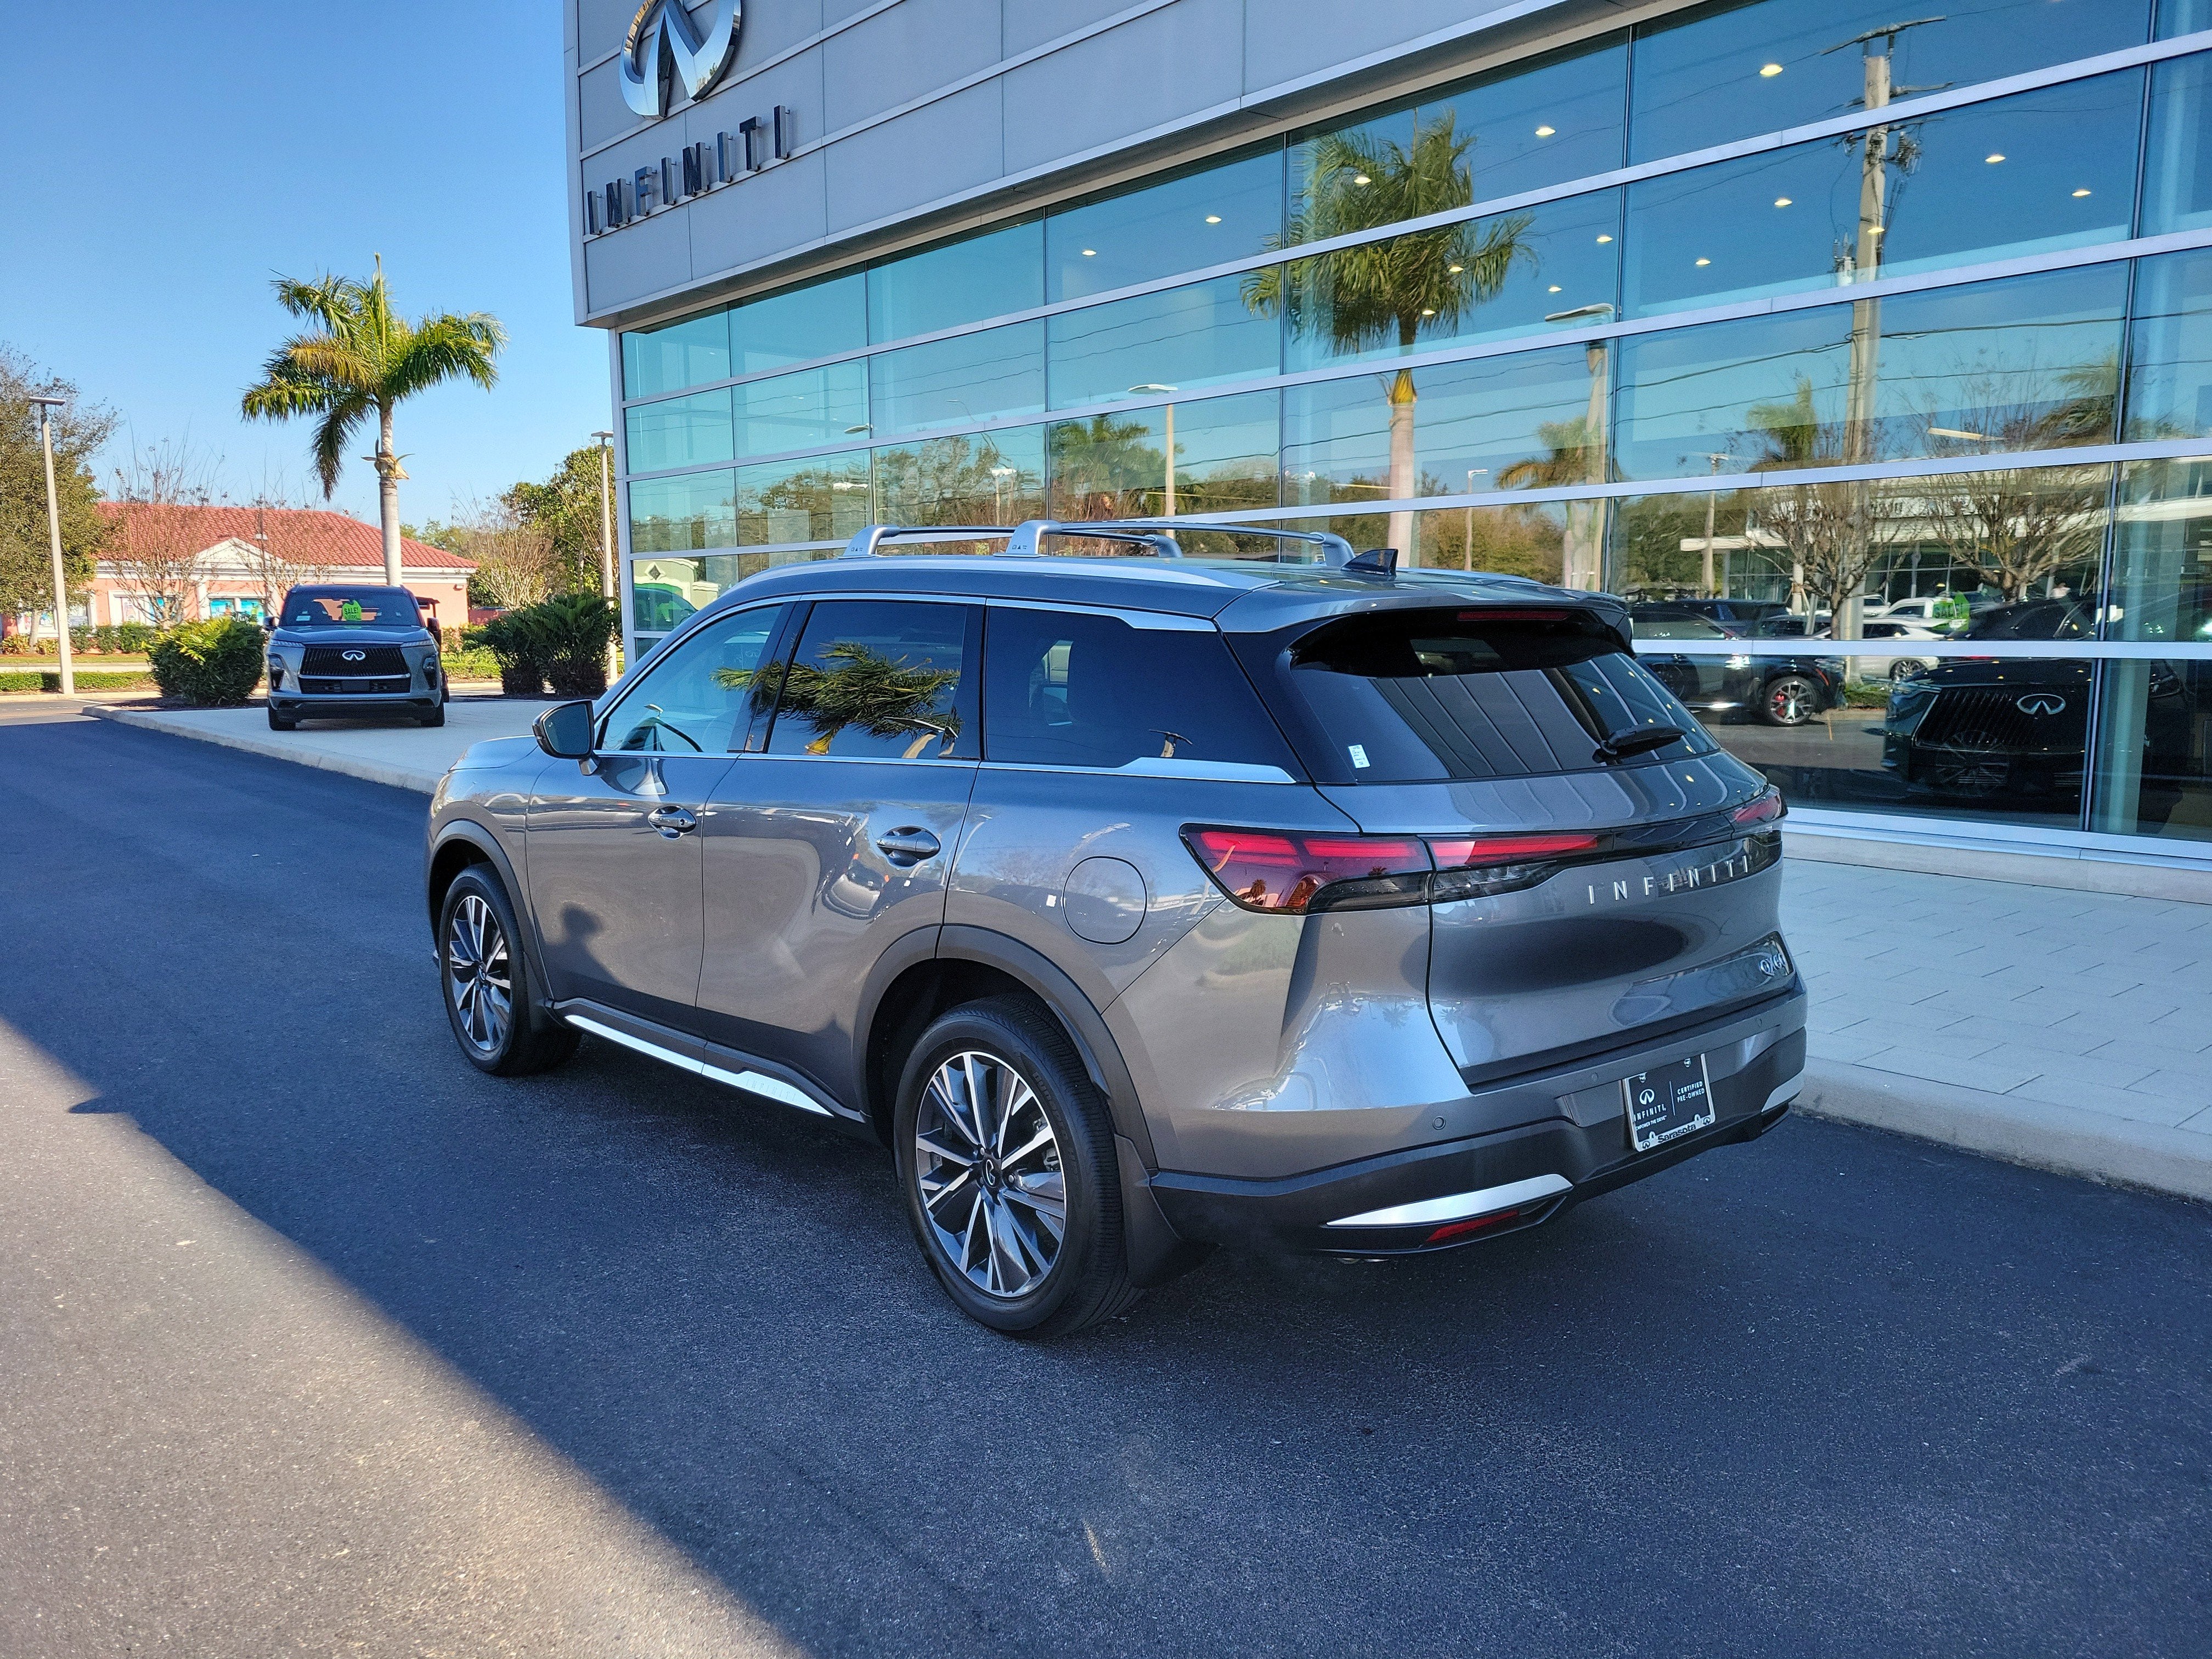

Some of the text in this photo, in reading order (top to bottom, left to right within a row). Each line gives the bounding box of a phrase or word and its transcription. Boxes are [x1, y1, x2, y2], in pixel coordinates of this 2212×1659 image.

[587, 105, 789, 235] INFINITI
[1588, 855, 1749, 905] INFINITI
[1759, 953, 1786, 976] QX60
[1677, 1081, 1703, 1095] CERTIFIED
[1677, 1088, 1705, 1103] PRE-OWNED
[1634, 1103, 1665, 1122] INFINITI
[1657, 1124, 1696, 1143] Sarasota
